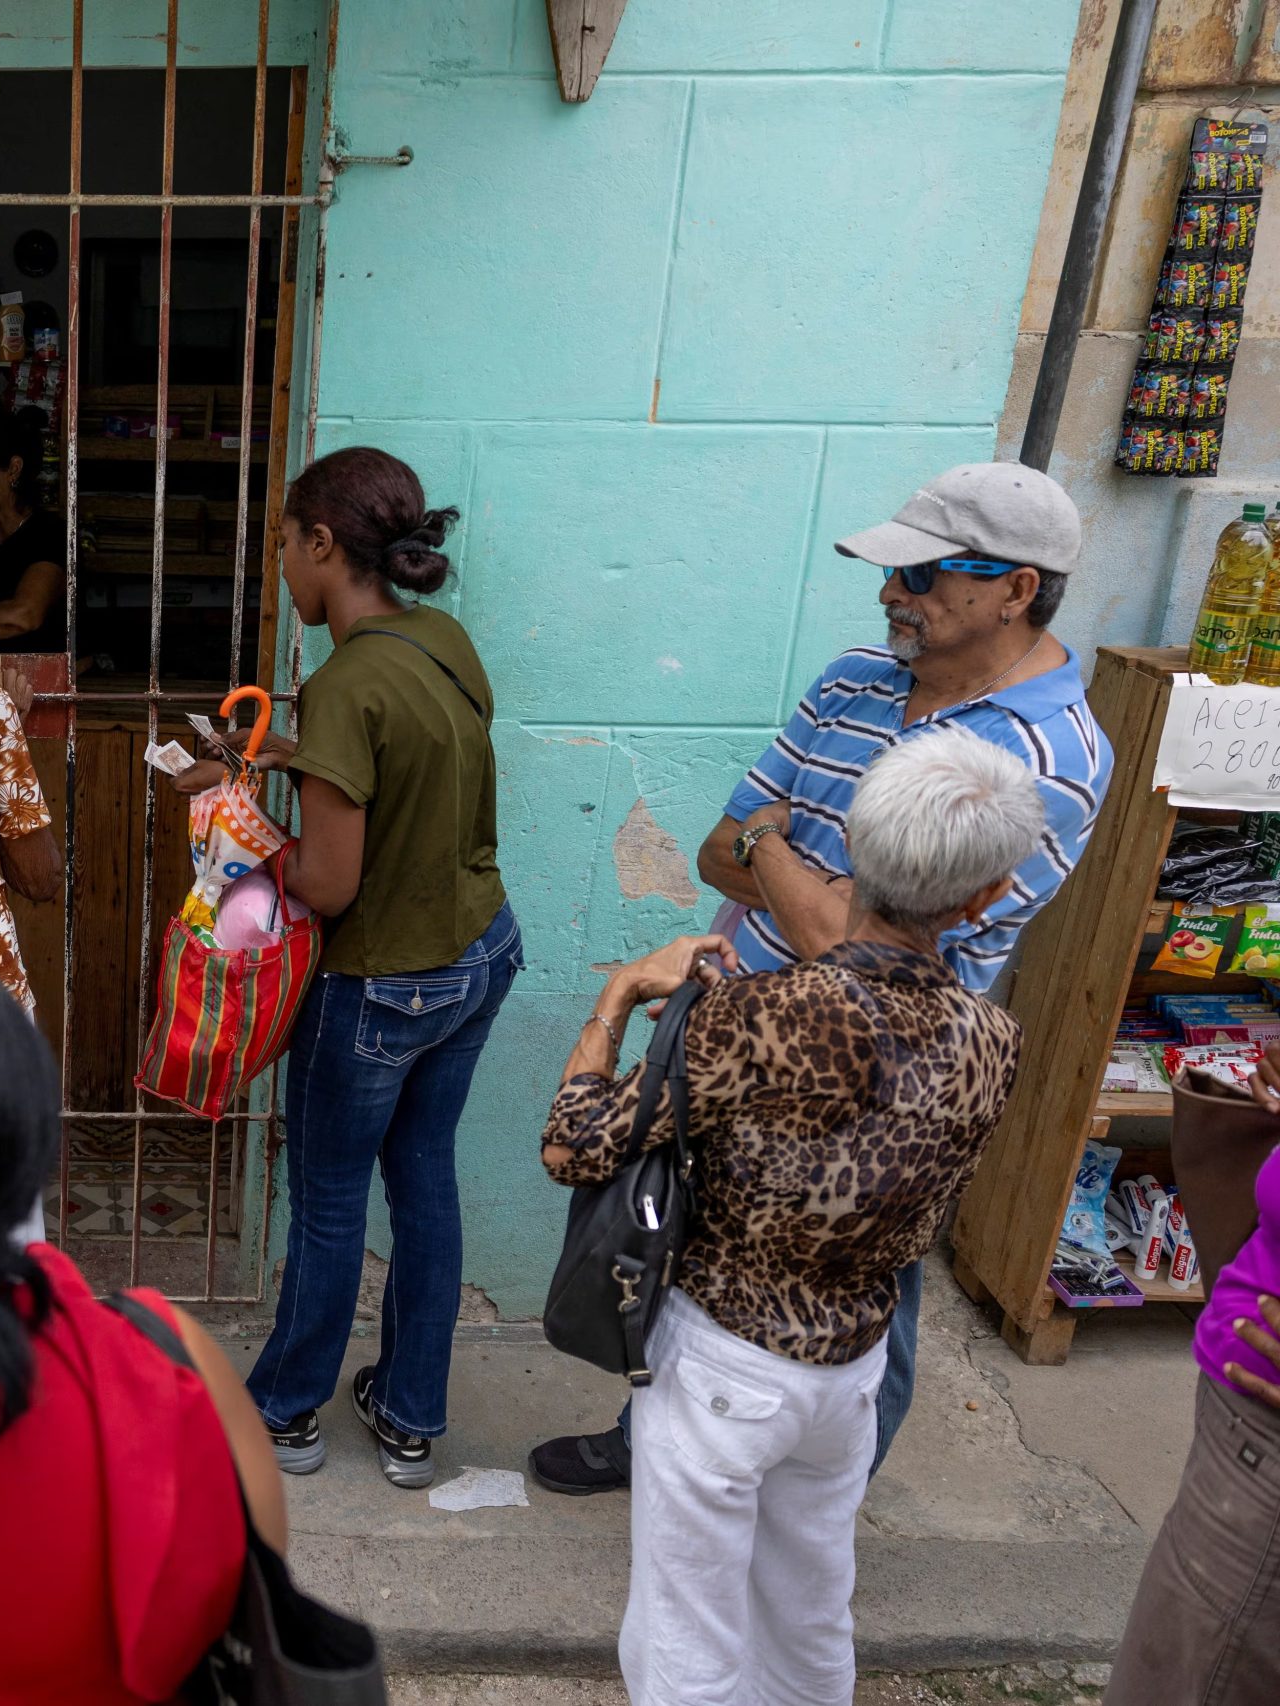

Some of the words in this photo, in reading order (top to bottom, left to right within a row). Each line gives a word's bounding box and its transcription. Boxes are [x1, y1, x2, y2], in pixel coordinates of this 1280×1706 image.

[1208, 153, 1217, 187] OTONETAS
[1198, 206, 1209, 247] BOTONETAS
[1238, 206, 1247, 247] BOTONETAS
[1187, 264, 1196, 305] BOTONETAS
[1229, 265, 1238, 305] BOTONETAS
[1158, 376, 1169, 414] BOTONETAS
[1208, 377, 1217, 414] BOTONETAS
[1145, 430, 1154, 468] BOTONETAS
[1200, 431, 1208, 469] BOTONETAS
[1197, 624, 1236, 640] amo
[1177, 918, 1218, 932] Frutal
[1248, 929, 1280, 941] Fruta
